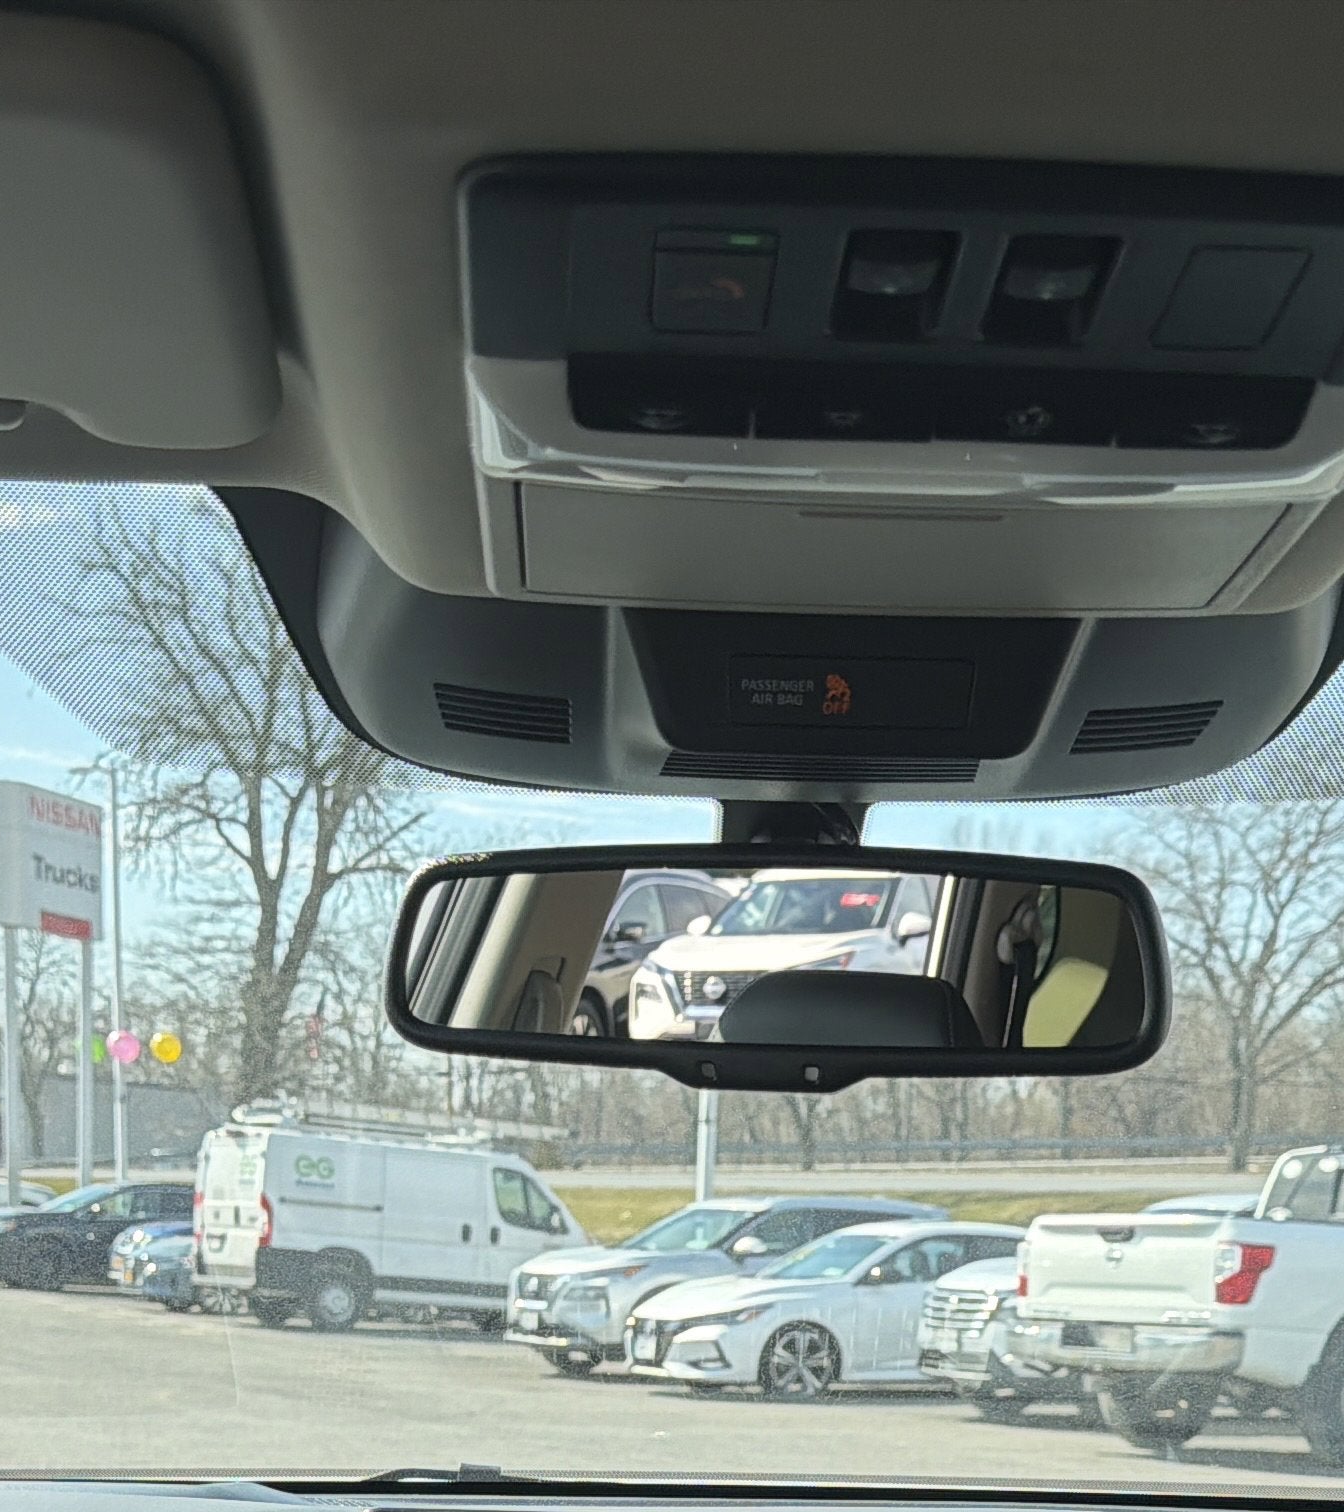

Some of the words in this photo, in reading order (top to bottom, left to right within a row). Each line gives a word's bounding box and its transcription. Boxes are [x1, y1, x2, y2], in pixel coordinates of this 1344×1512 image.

[742, 680, 814, 692] PASSENGER
[753, 694, 773, 705] AIR
[777, 694, 803, 706] BAG
[823, 702, 849, 715] OFF
[30, 796, 101, 837] NISSAN
[32, 852, 100, 893] Trucks
